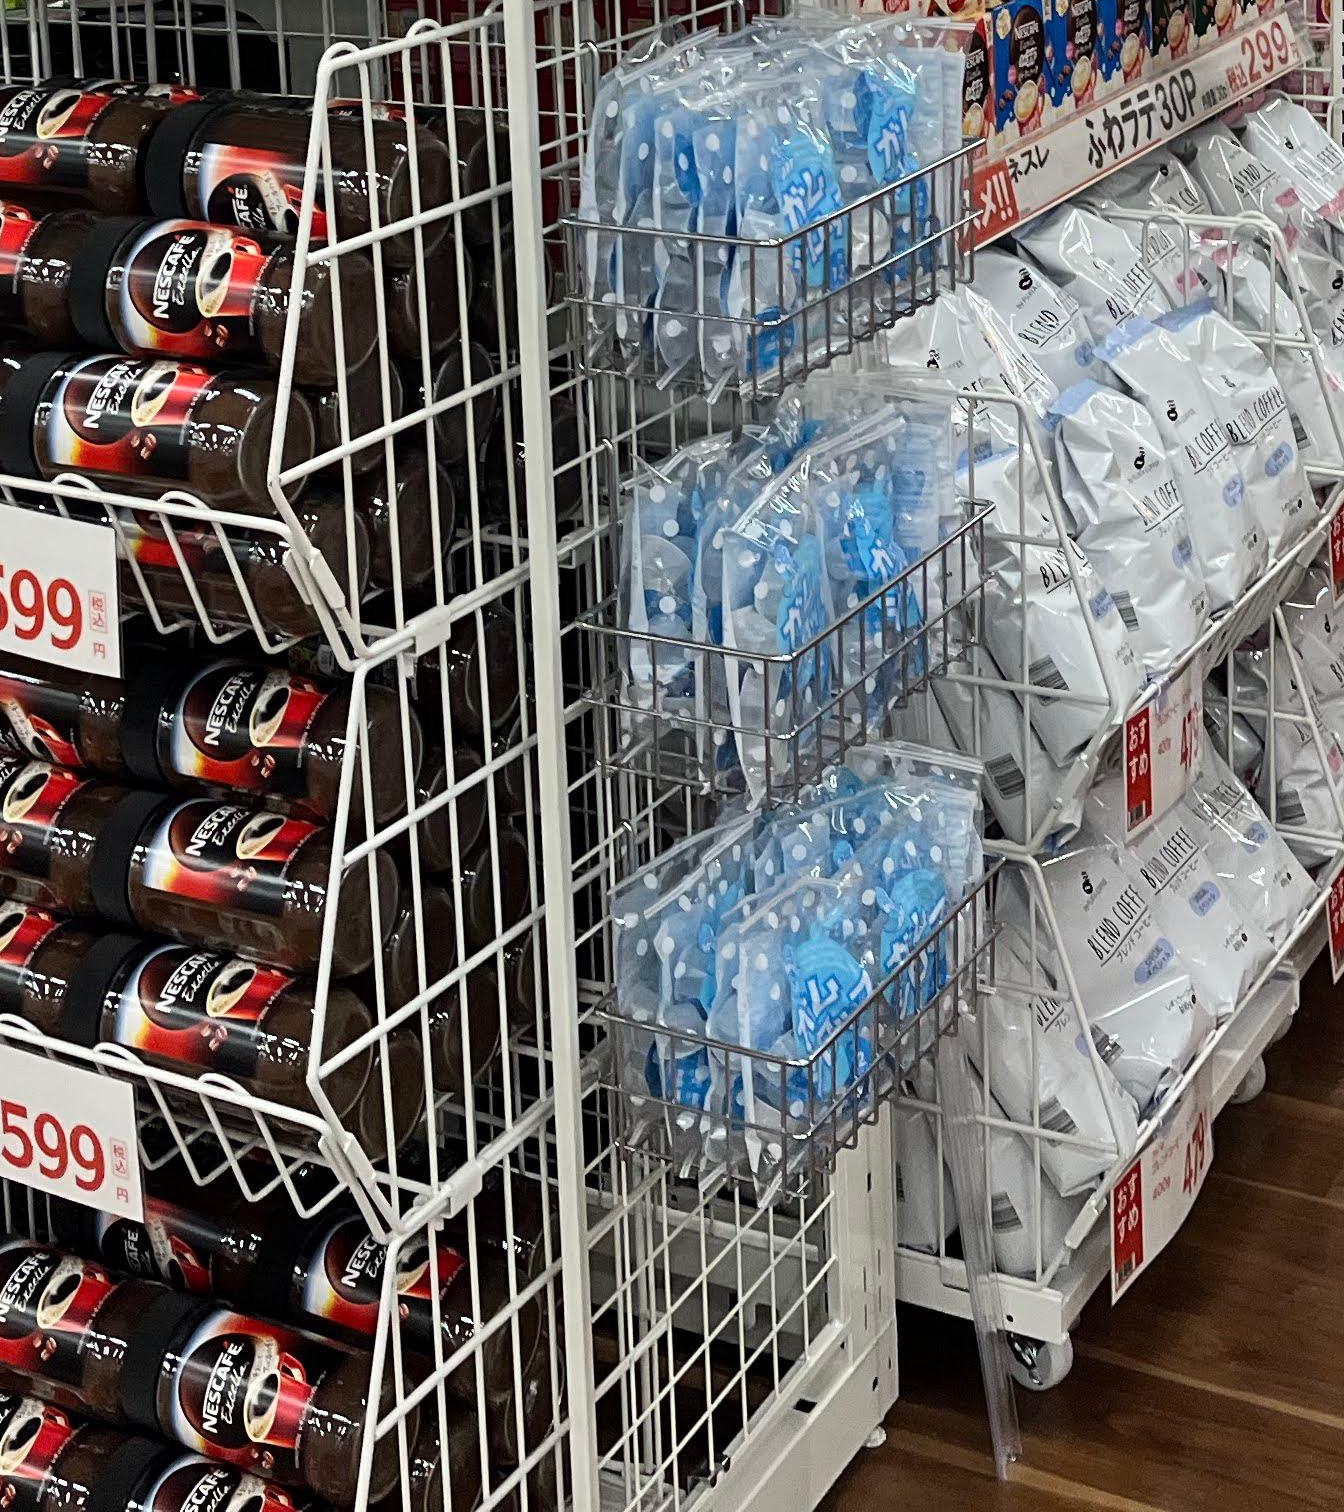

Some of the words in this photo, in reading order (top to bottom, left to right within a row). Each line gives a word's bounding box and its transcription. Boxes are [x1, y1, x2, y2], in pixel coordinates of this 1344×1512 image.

[1008, 144, 1051, 186] ネスレ
[1086, 67, 1198, 170] ふわラテ30P
[1240, 20, 1290, 80] 299
[0, 1098, 106, 1191] 599
